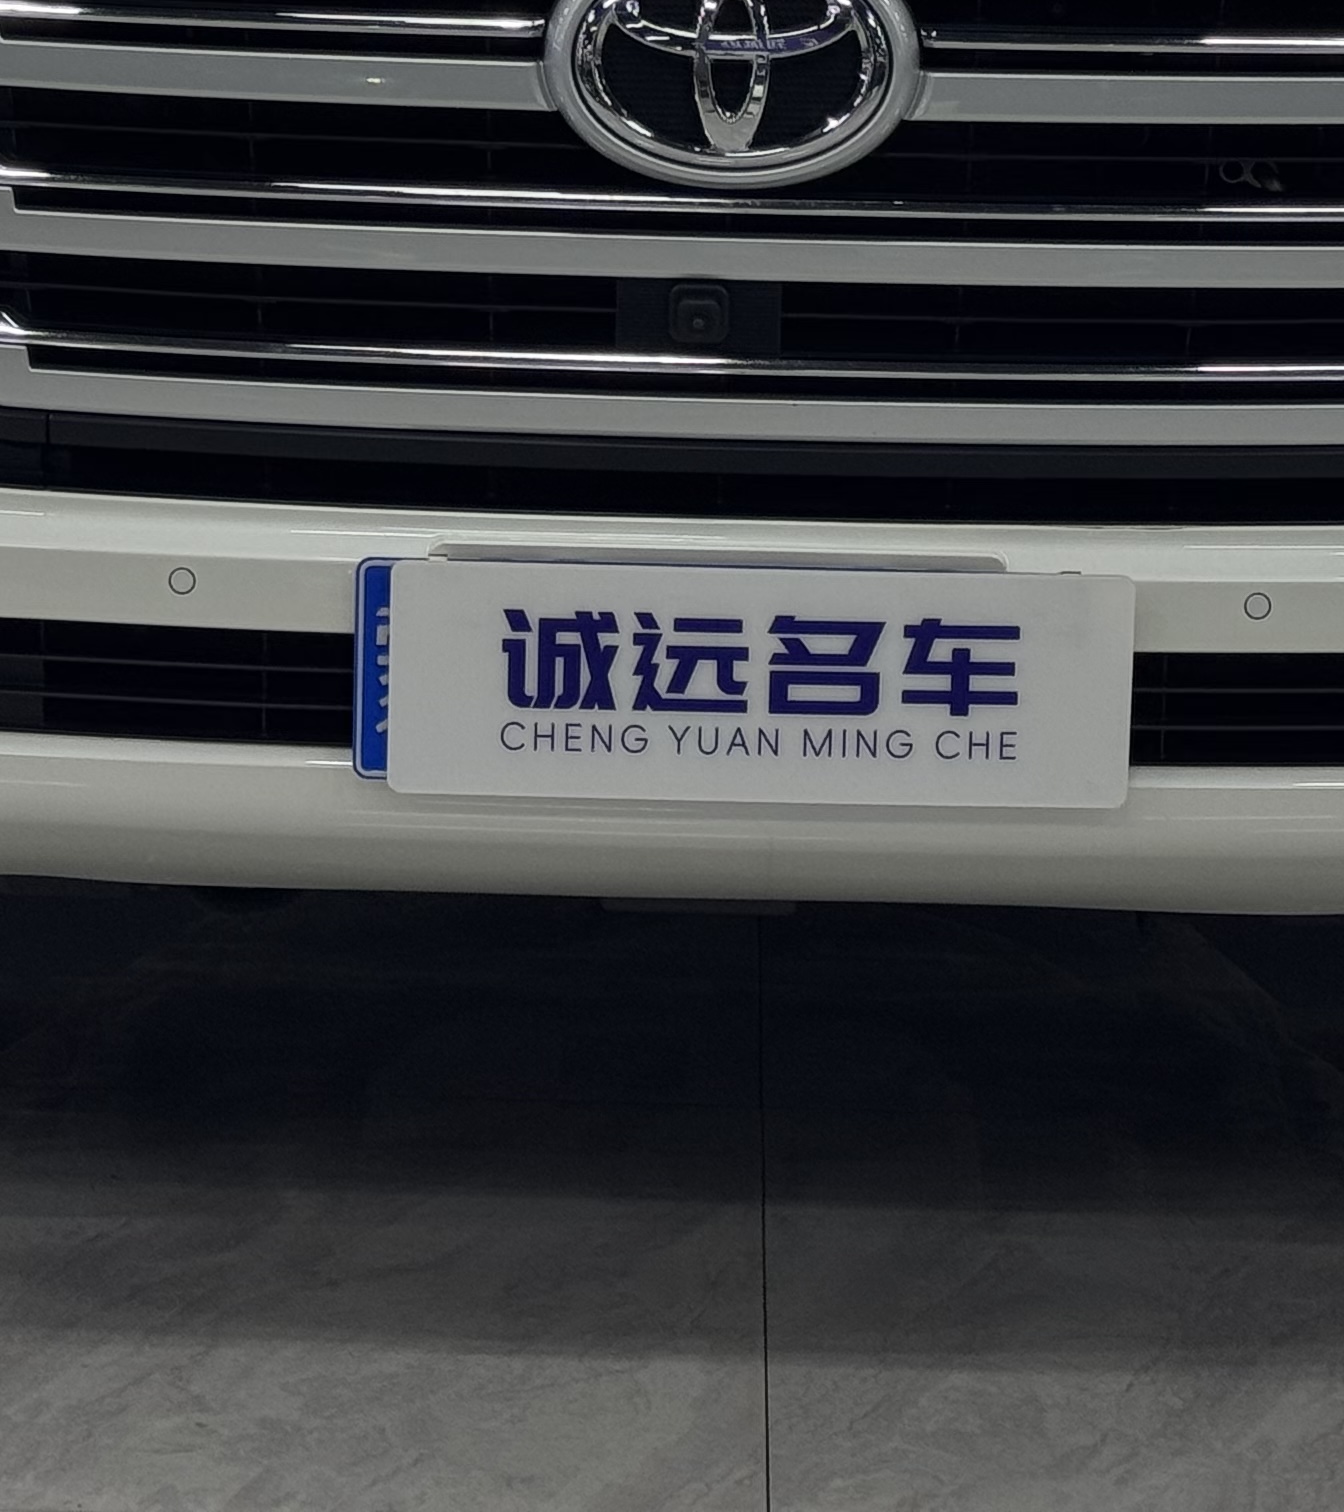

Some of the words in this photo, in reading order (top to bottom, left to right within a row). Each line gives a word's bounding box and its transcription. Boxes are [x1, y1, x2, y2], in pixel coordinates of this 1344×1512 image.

[501, 608, 1023, 718] 诚远名车
[500, 720, 649, 754] CHENG
[667, 724, 781, 757] YUAN
[802, 727, 915, 760] MING
[934, 729, 1019, 762] CHE
